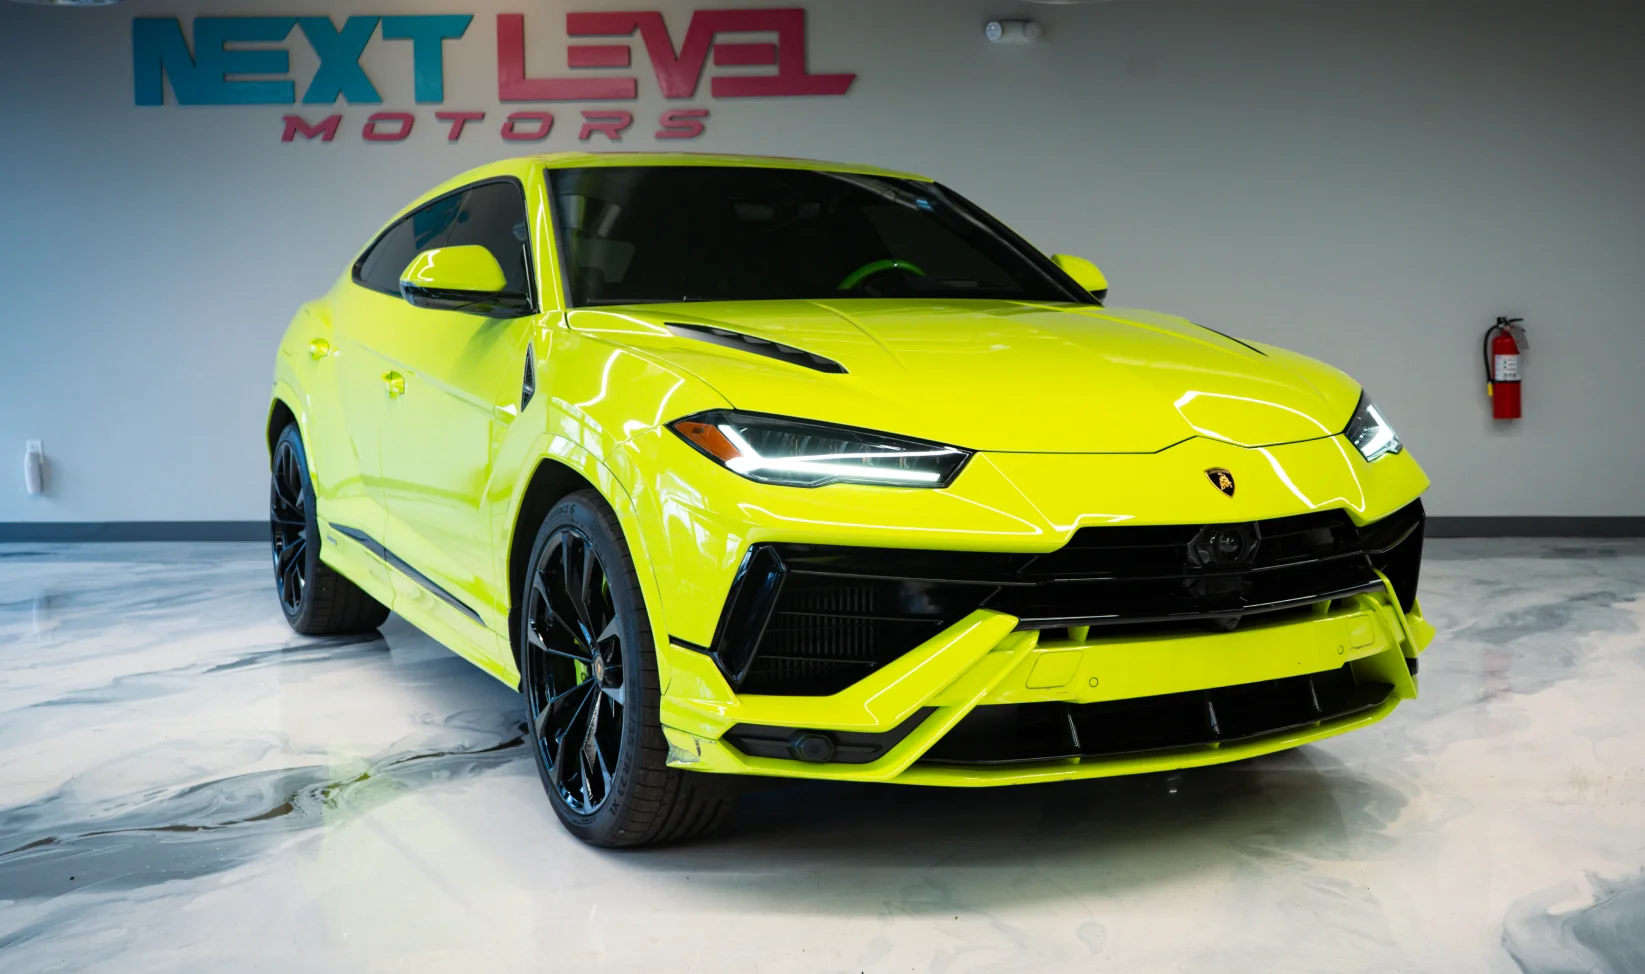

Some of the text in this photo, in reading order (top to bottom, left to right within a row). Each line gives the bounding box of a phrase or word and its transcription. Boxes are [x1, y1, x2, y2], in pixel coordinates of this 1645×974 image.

[133, 8, 855, 106] NEXT LEVEL
[281, 109, 710, 142] MOTORS
